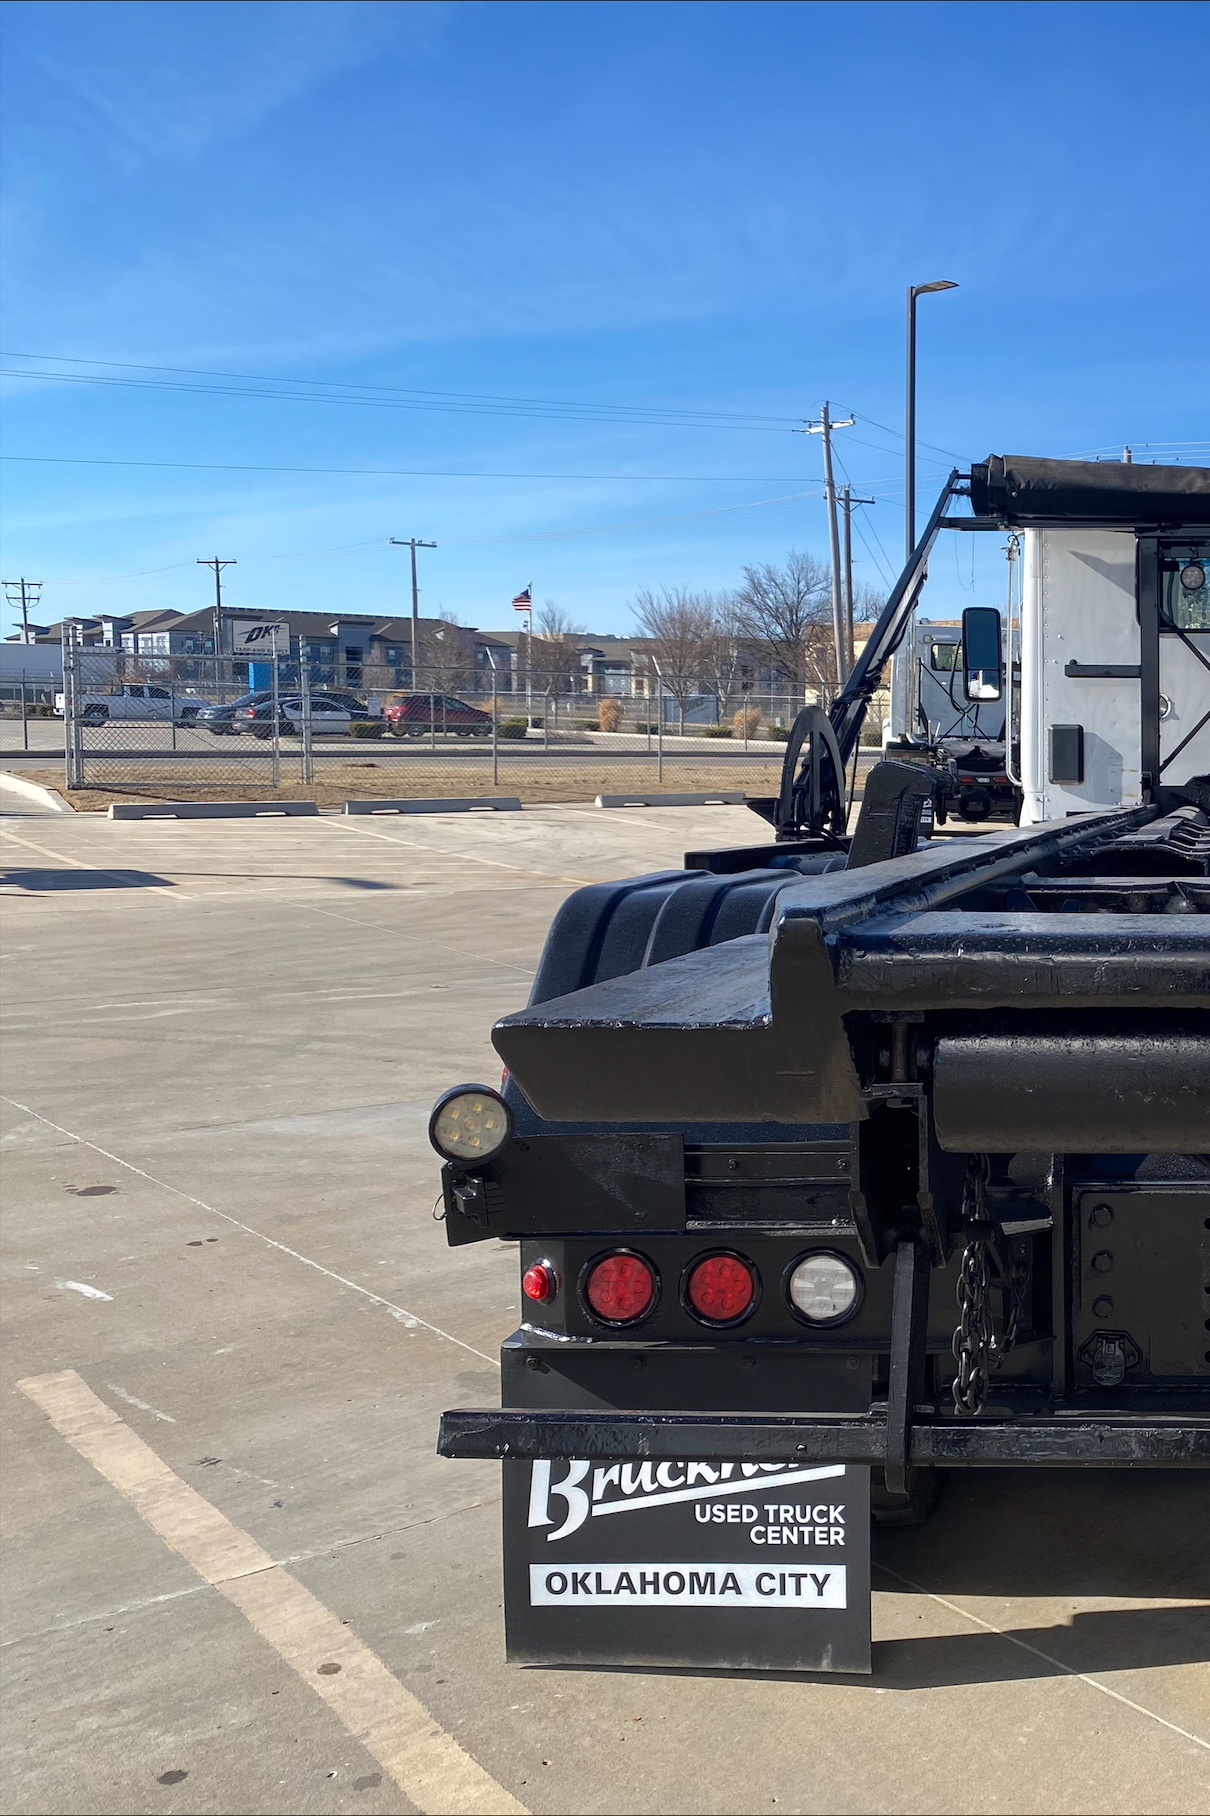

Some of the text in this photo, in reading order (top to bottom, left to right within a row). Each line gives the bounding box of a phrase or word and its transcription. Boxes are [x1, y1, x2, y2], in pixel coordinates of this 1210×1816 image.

[694, 1504, 845, 1524] USED TRUCK
[749, 1526, 845, 1546] CENTER
[545, 1571, 831, 1597] OKLAHOMA CITY
